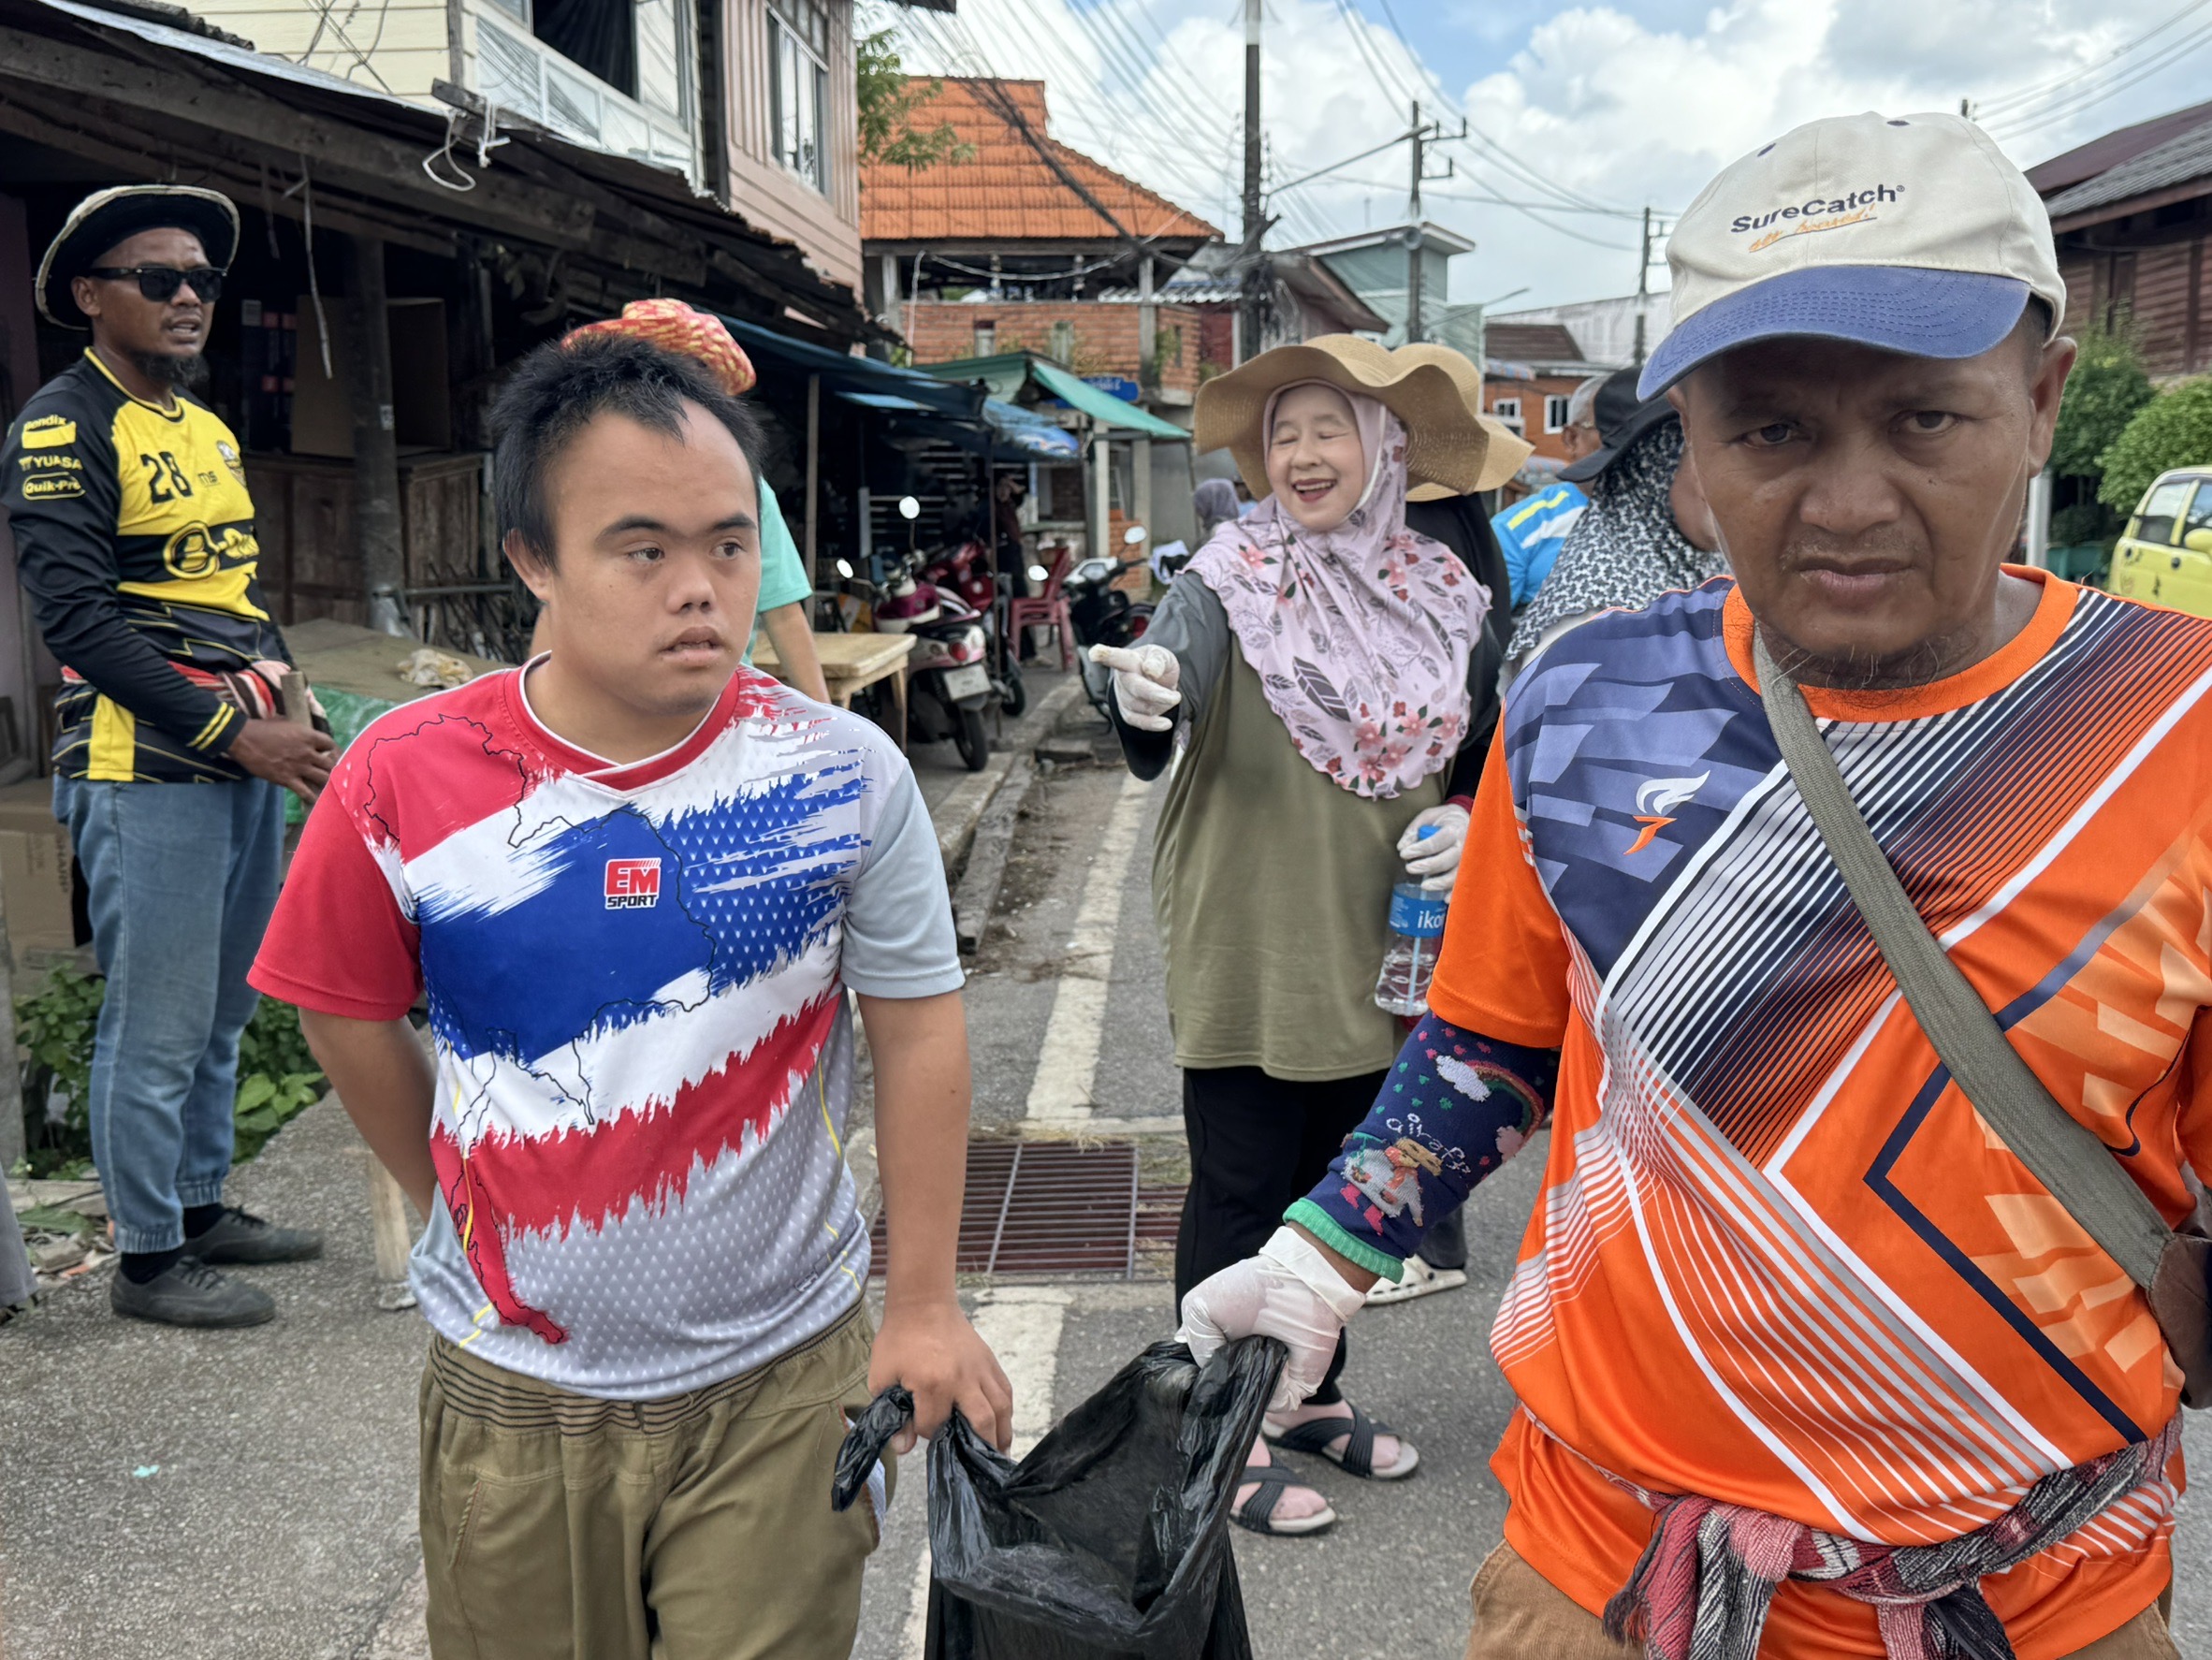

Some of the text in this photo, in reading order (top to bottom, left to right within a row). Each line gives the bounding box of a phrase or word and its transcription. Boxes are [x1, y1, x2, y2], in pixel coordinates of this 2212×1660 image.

[34, 456, 83, 470] YUASA
[140, 451, 193, 503] 28
[606, 860, 661, 895] EM
[606, 896, 658, 908] SPORT
